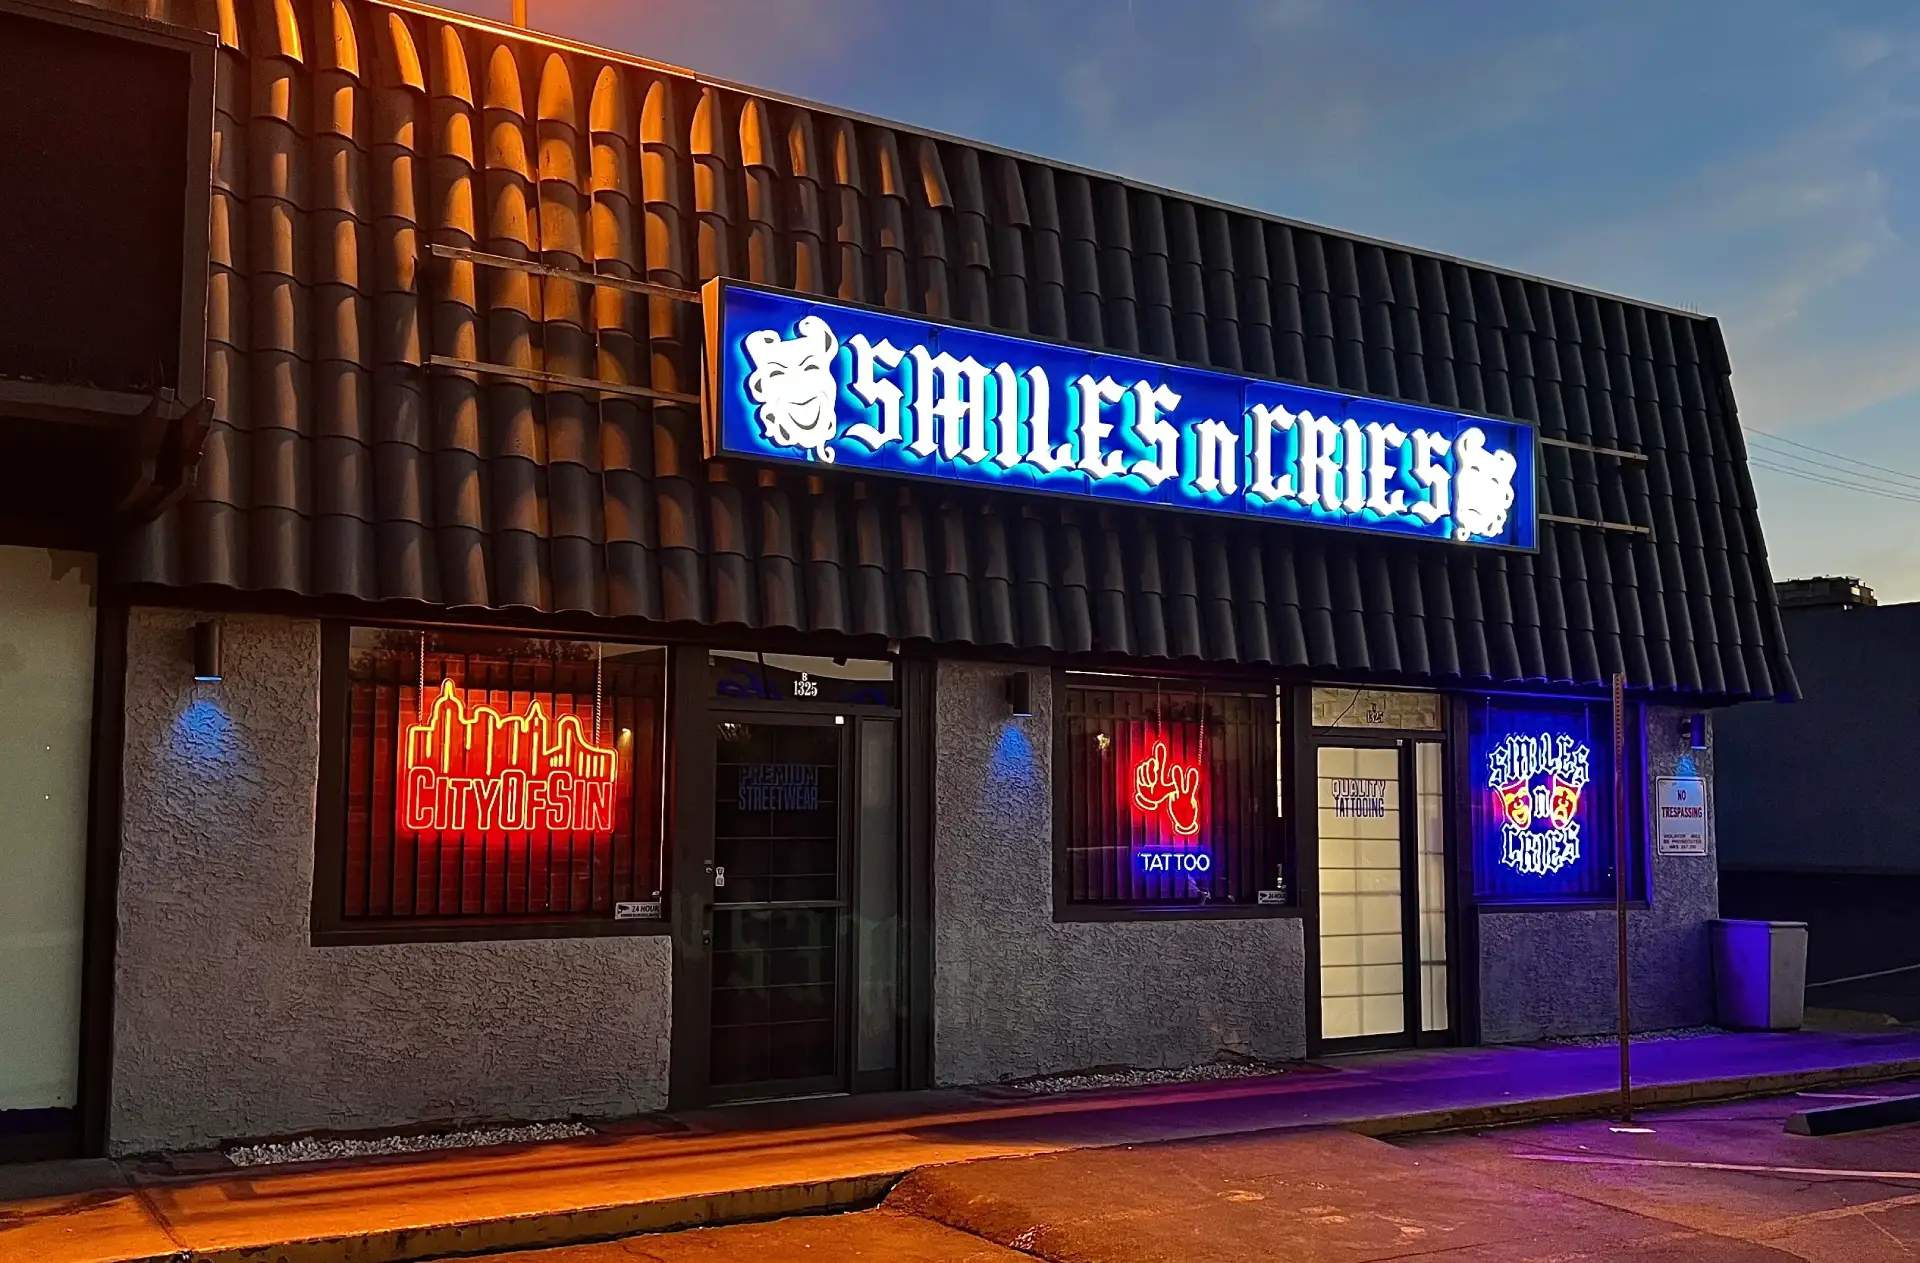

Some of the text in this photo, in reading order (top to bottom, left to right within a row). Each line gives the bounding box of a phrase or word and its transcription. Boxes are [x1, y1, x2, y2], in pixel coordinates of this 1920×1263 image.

[840, 334, 1182, 487] SMILES
[1243, 403, 1452, 524] CRIES
[793, 681, 818, 697] 1325
[1488, 732, 1591, 788] SMILES
[738, 785, 819, 811] STREETWEAR
[1331, 778, 1387, 799] QUALITY
[1677, 789, 1687, 801] NO
[1335, 797, 1385, 818] TATTOOING
[1661, 806, 1703, 818] TRESPASSING
[1501, 820, 1581, 875] CRIES
[1140, 853, 1211, 872] TATTOO
[631, 905, 660, 913] 24 HOUR
